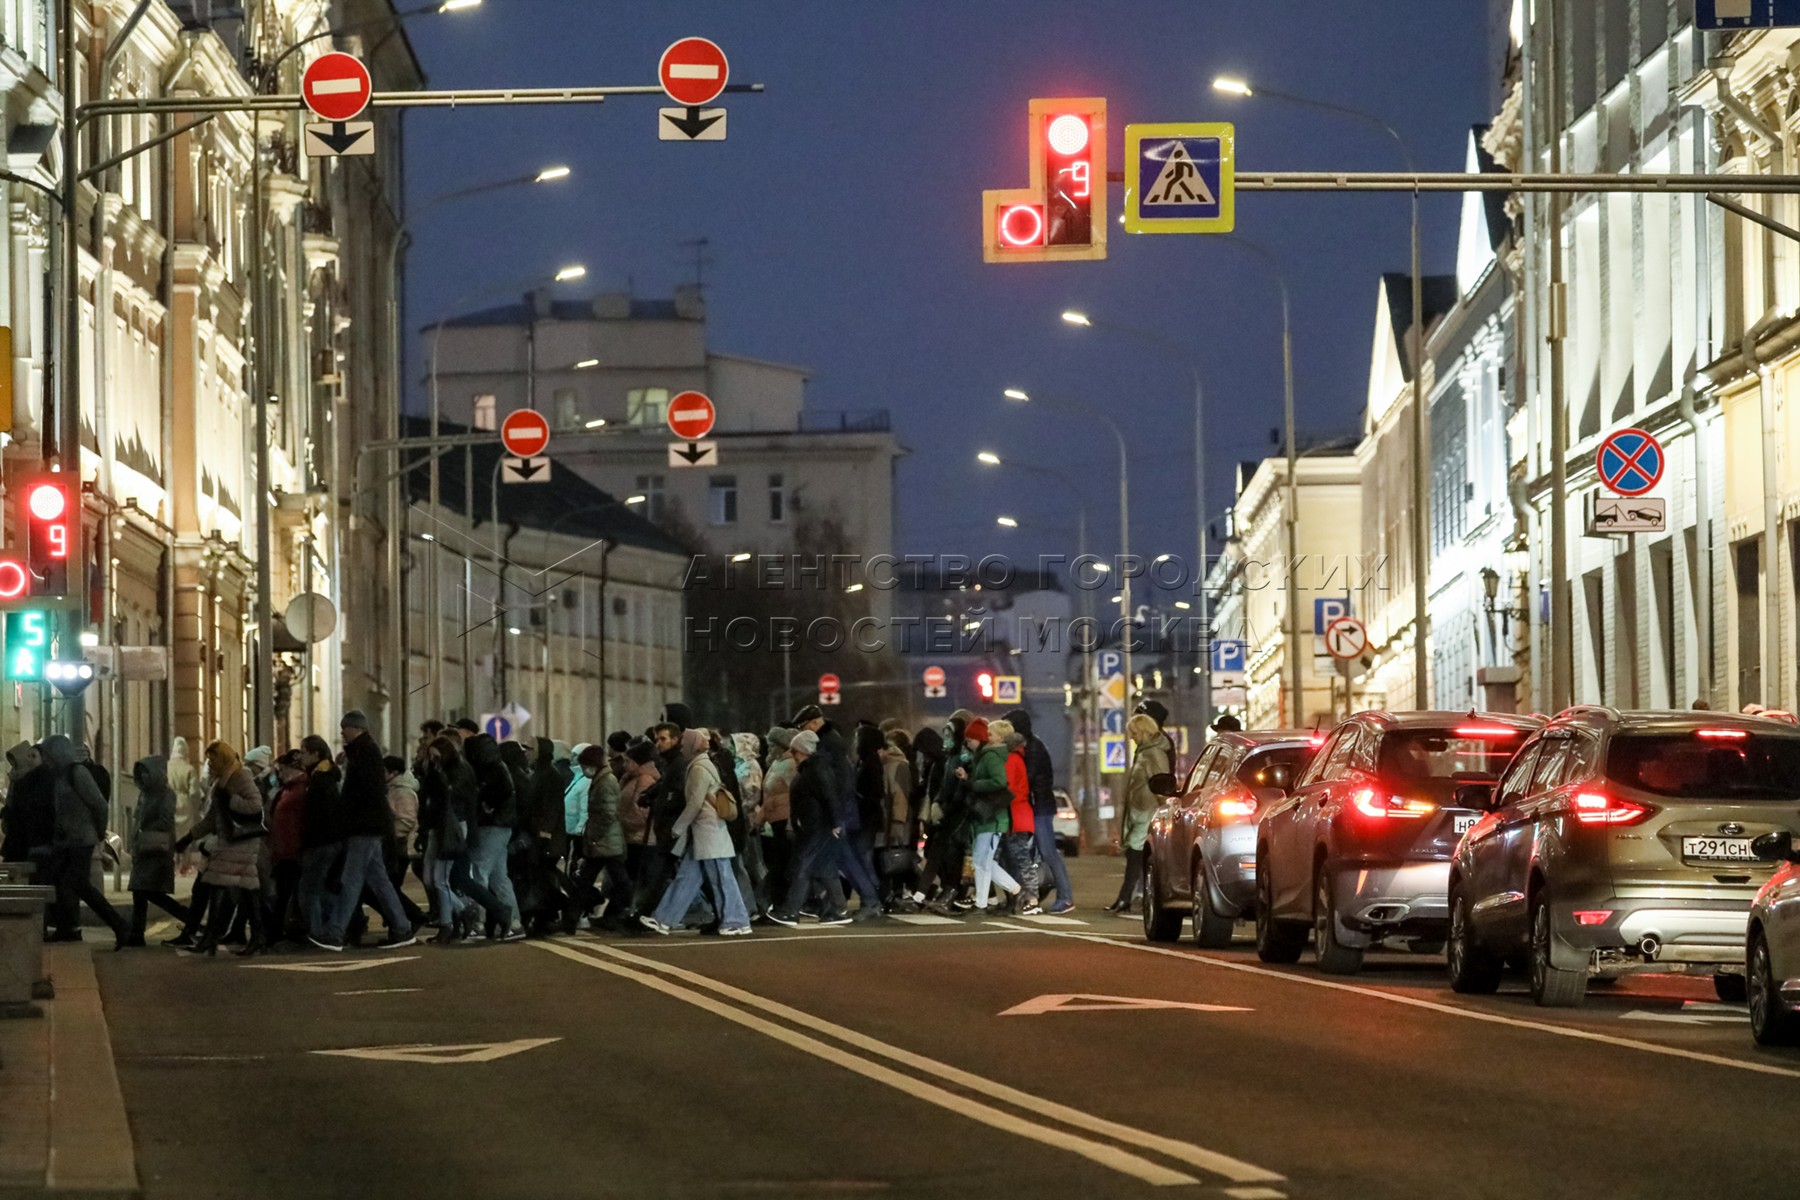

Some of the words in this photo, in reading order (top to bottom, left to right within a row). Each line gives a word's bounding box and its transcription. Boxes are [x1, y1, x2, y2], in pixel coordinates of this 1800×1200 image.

[1072, 161, 1090, 197] 9
[49, 524, 66, 557] 9
[24, 613, 44, 646] 5
[1103, 653, 1119, 675] P
[1218, 642, 1239, 669] P
